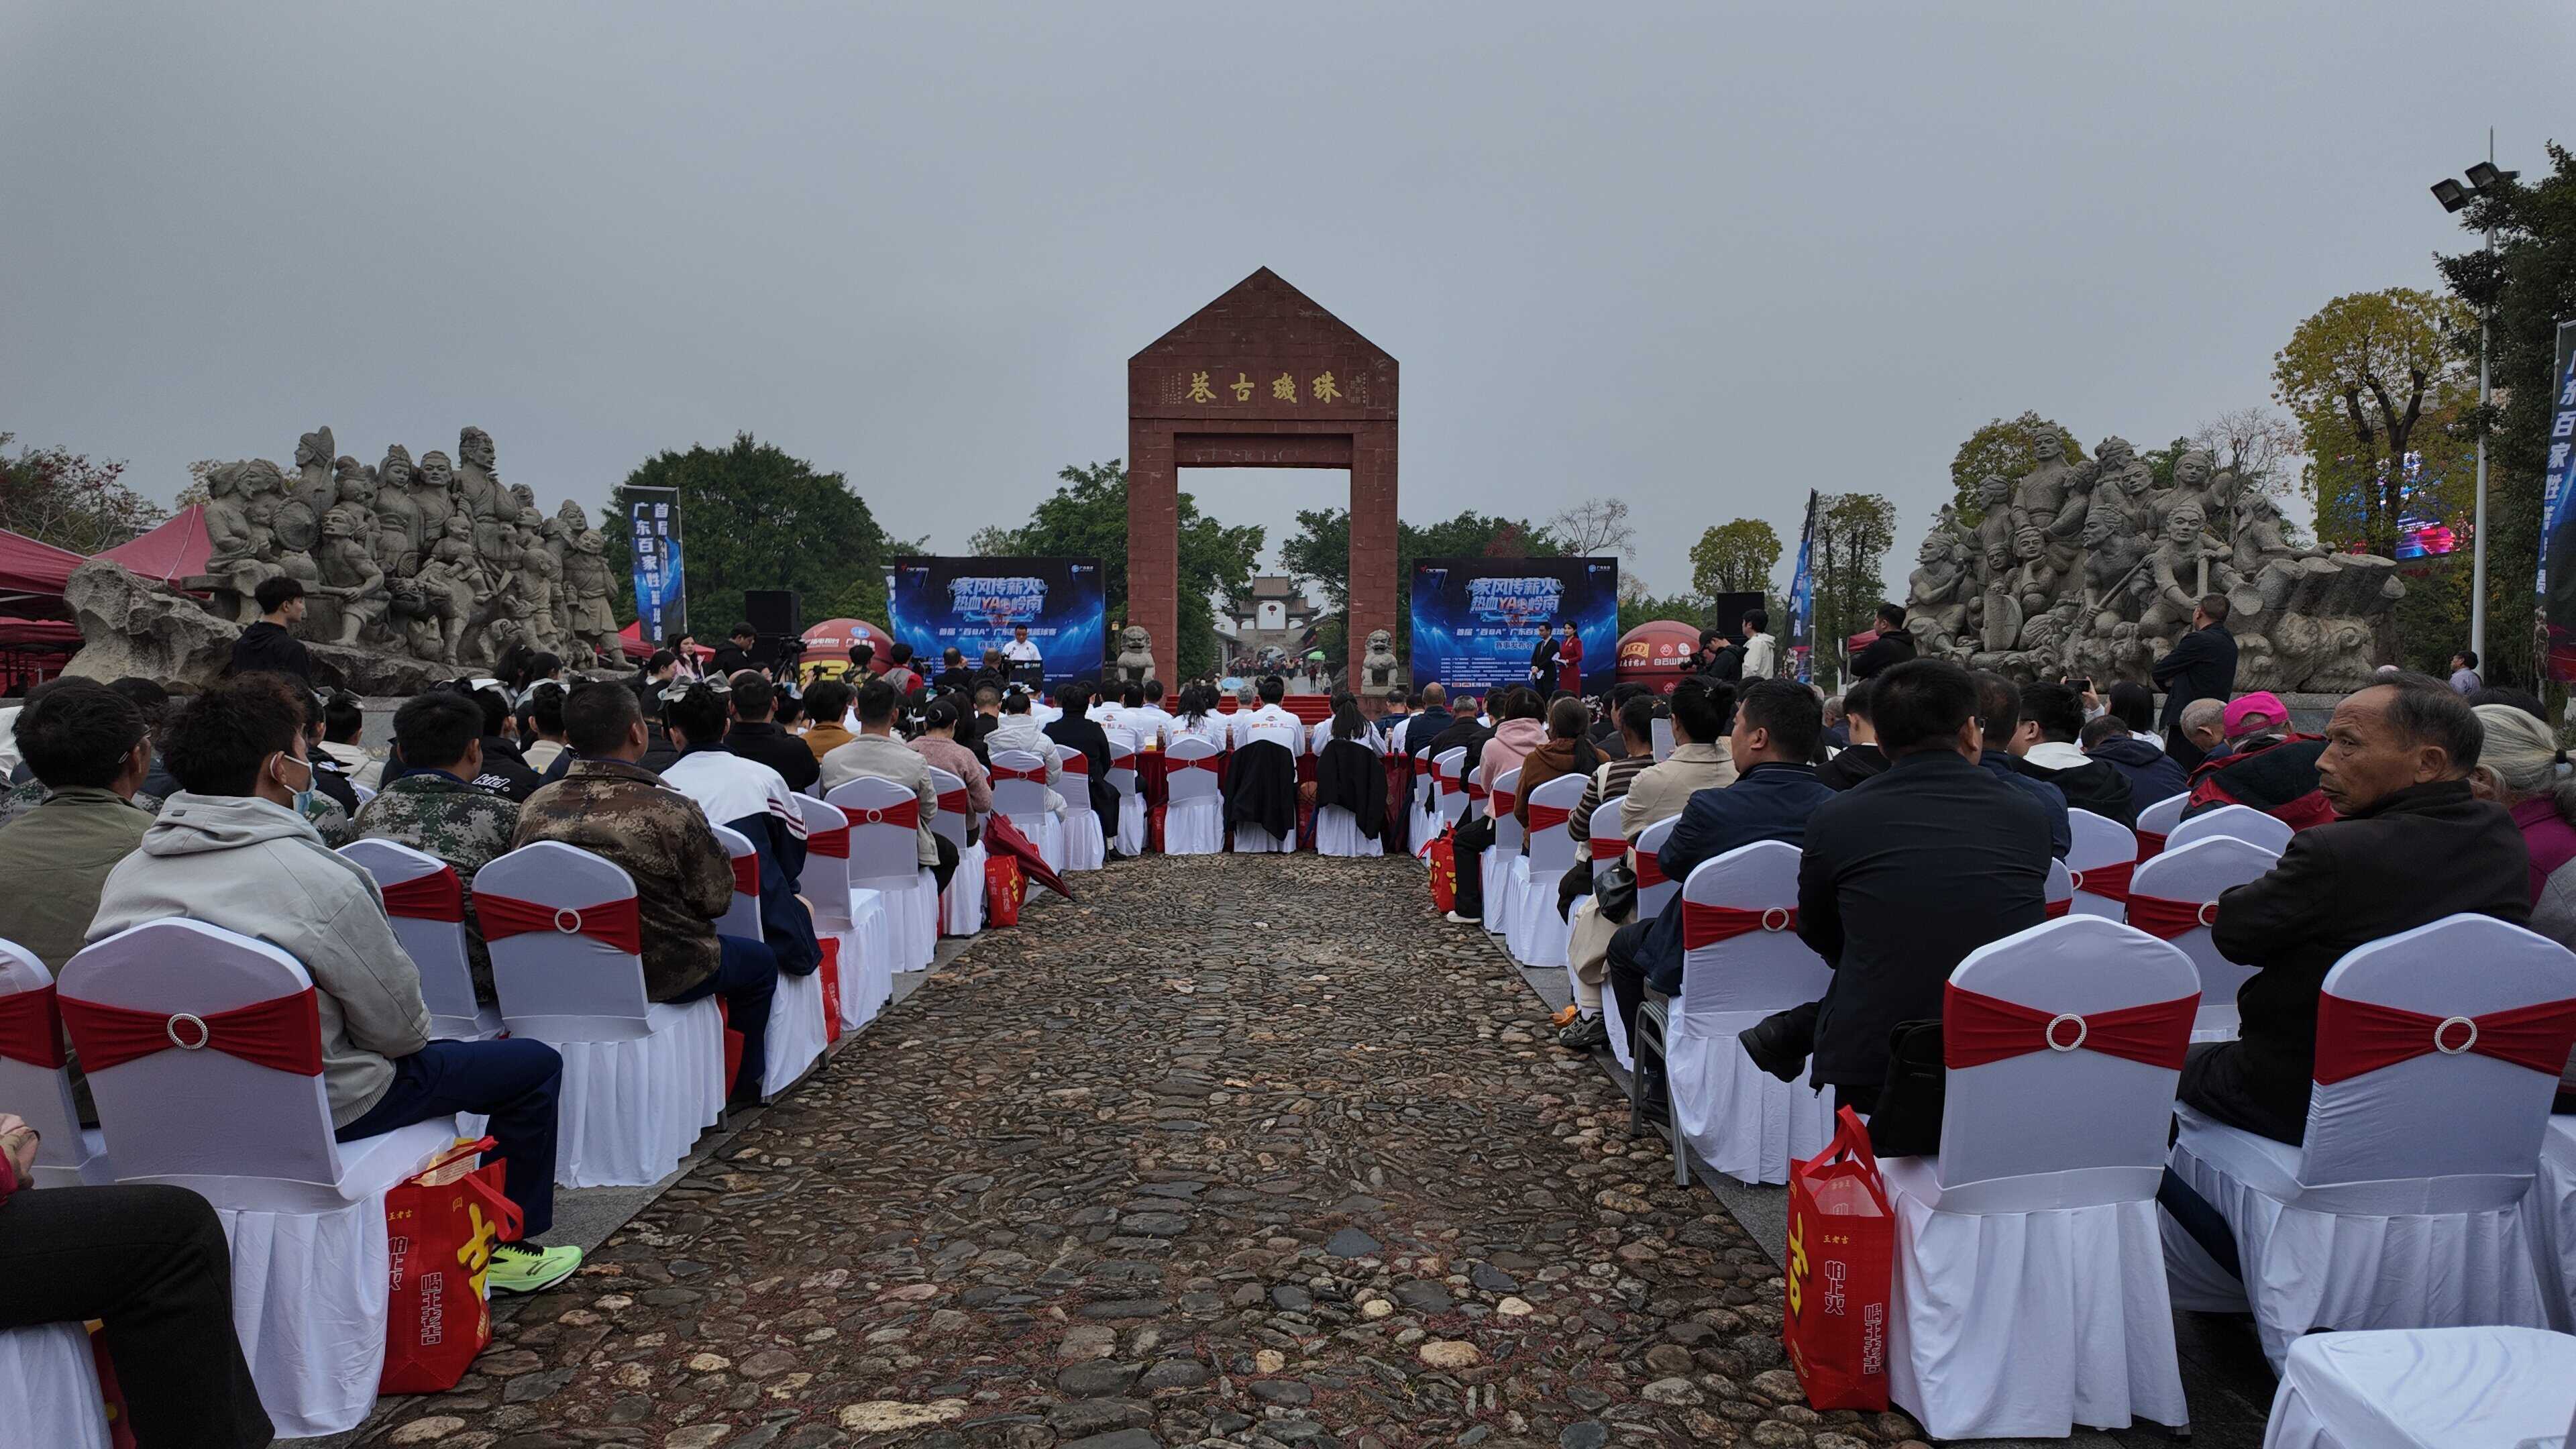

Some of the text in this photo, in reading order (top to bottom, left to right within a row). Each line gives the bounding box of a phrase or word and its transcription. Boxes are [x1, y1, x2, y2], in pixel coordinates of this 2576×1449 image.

[955, 577, 1040, 595] 家风传薪火
[1472, 577, 1557, 595] 家风传薪火
[388, 1209, 413, 1221] 王老吉
[1823, 1235, 1849, 1244] 王老吉
[1824, 1260, 1846, 1316] 怕上火
